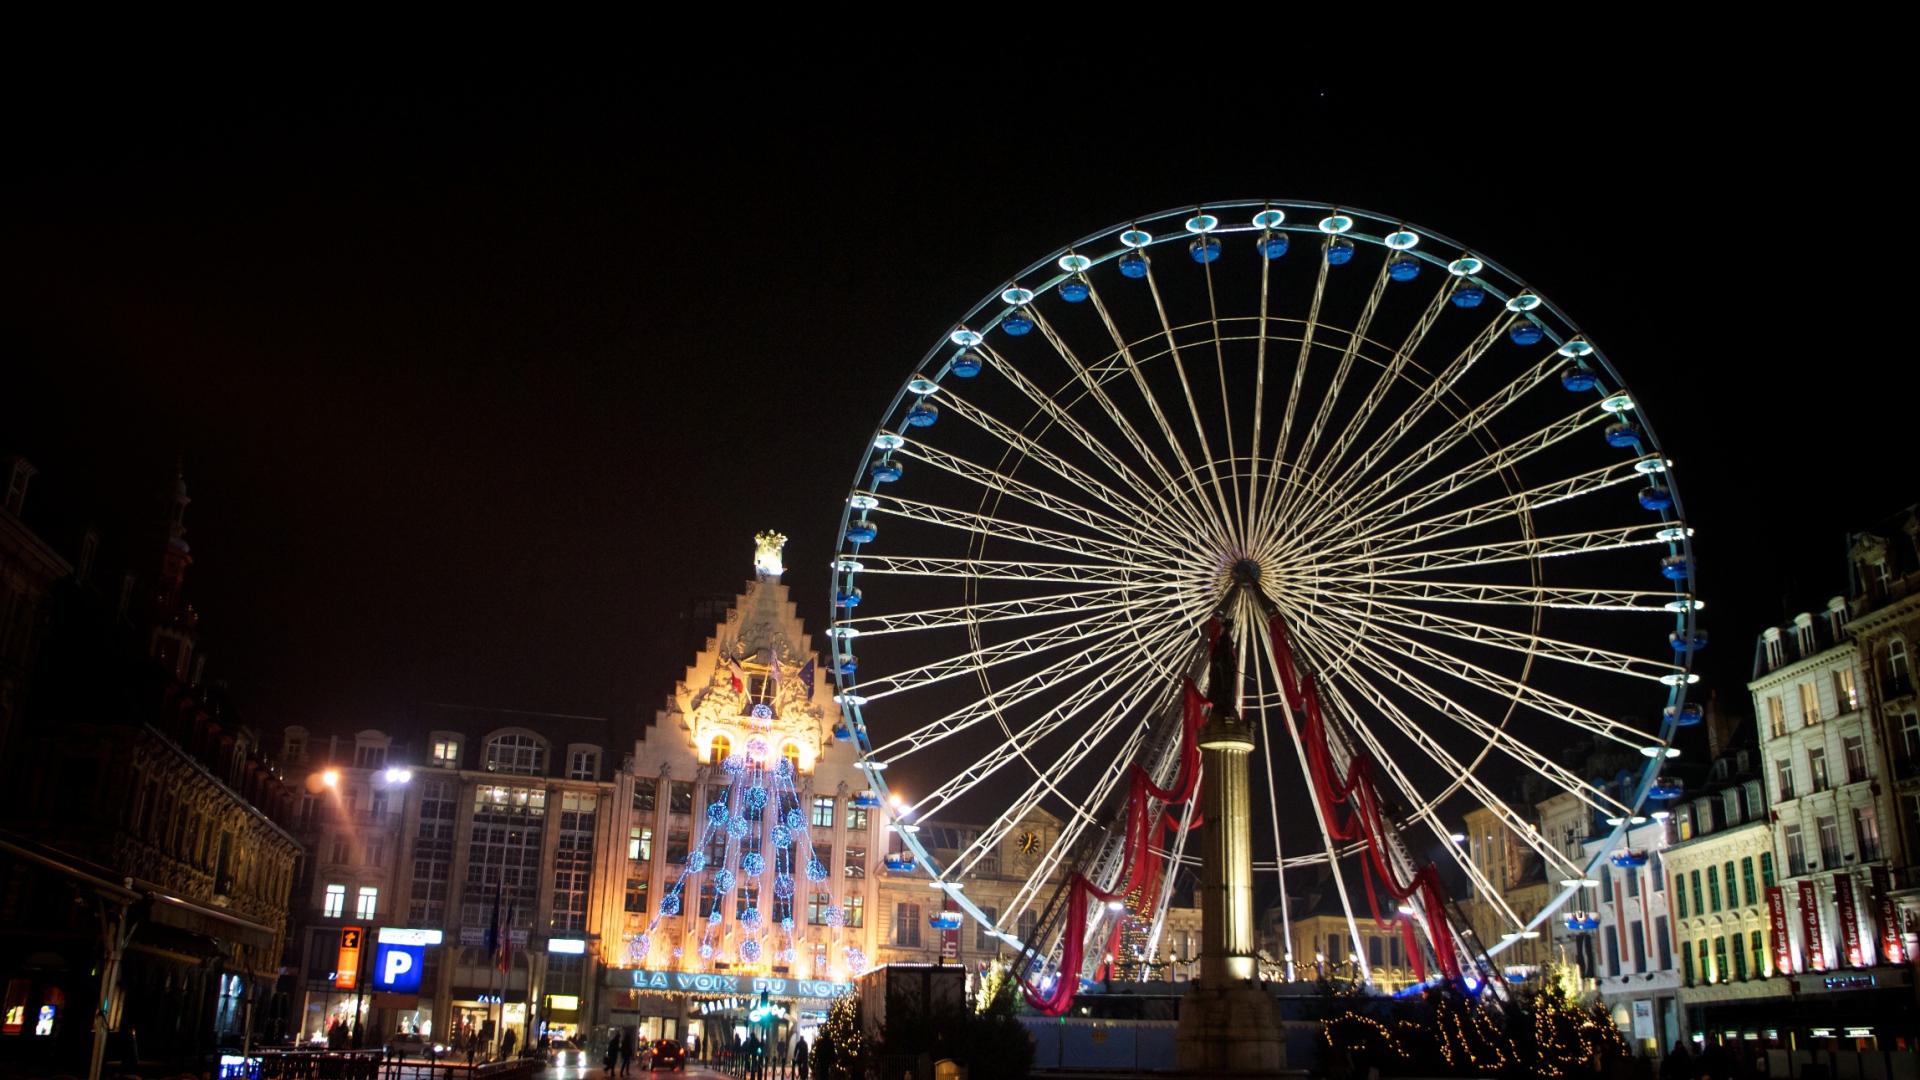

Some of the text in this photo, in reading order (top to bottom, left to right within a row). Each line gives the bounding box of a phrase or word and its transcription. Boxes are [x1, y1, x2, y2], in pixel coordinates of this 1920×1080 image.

[1803, 887, 1814, 909] nord
[1841, 881, 1850, 903] nord
[1772, 893, 1782, 915] nord
[1844, 906, 1853, 919] du
[1882, 901, 1891, 914] du
[1776, 917, 1784, 930] du
[1807, 912, 1816, 924] du
[1885, 916, 1896, 942] furet
[1777, 931, 1787, 955] furet
[1810, 927, 1819, 950] furet
[1847, 922, 1857, 946] furet
[384, 951, 412, 984] P
[633, 969, 854, 999] LA VOIX DU NOR
